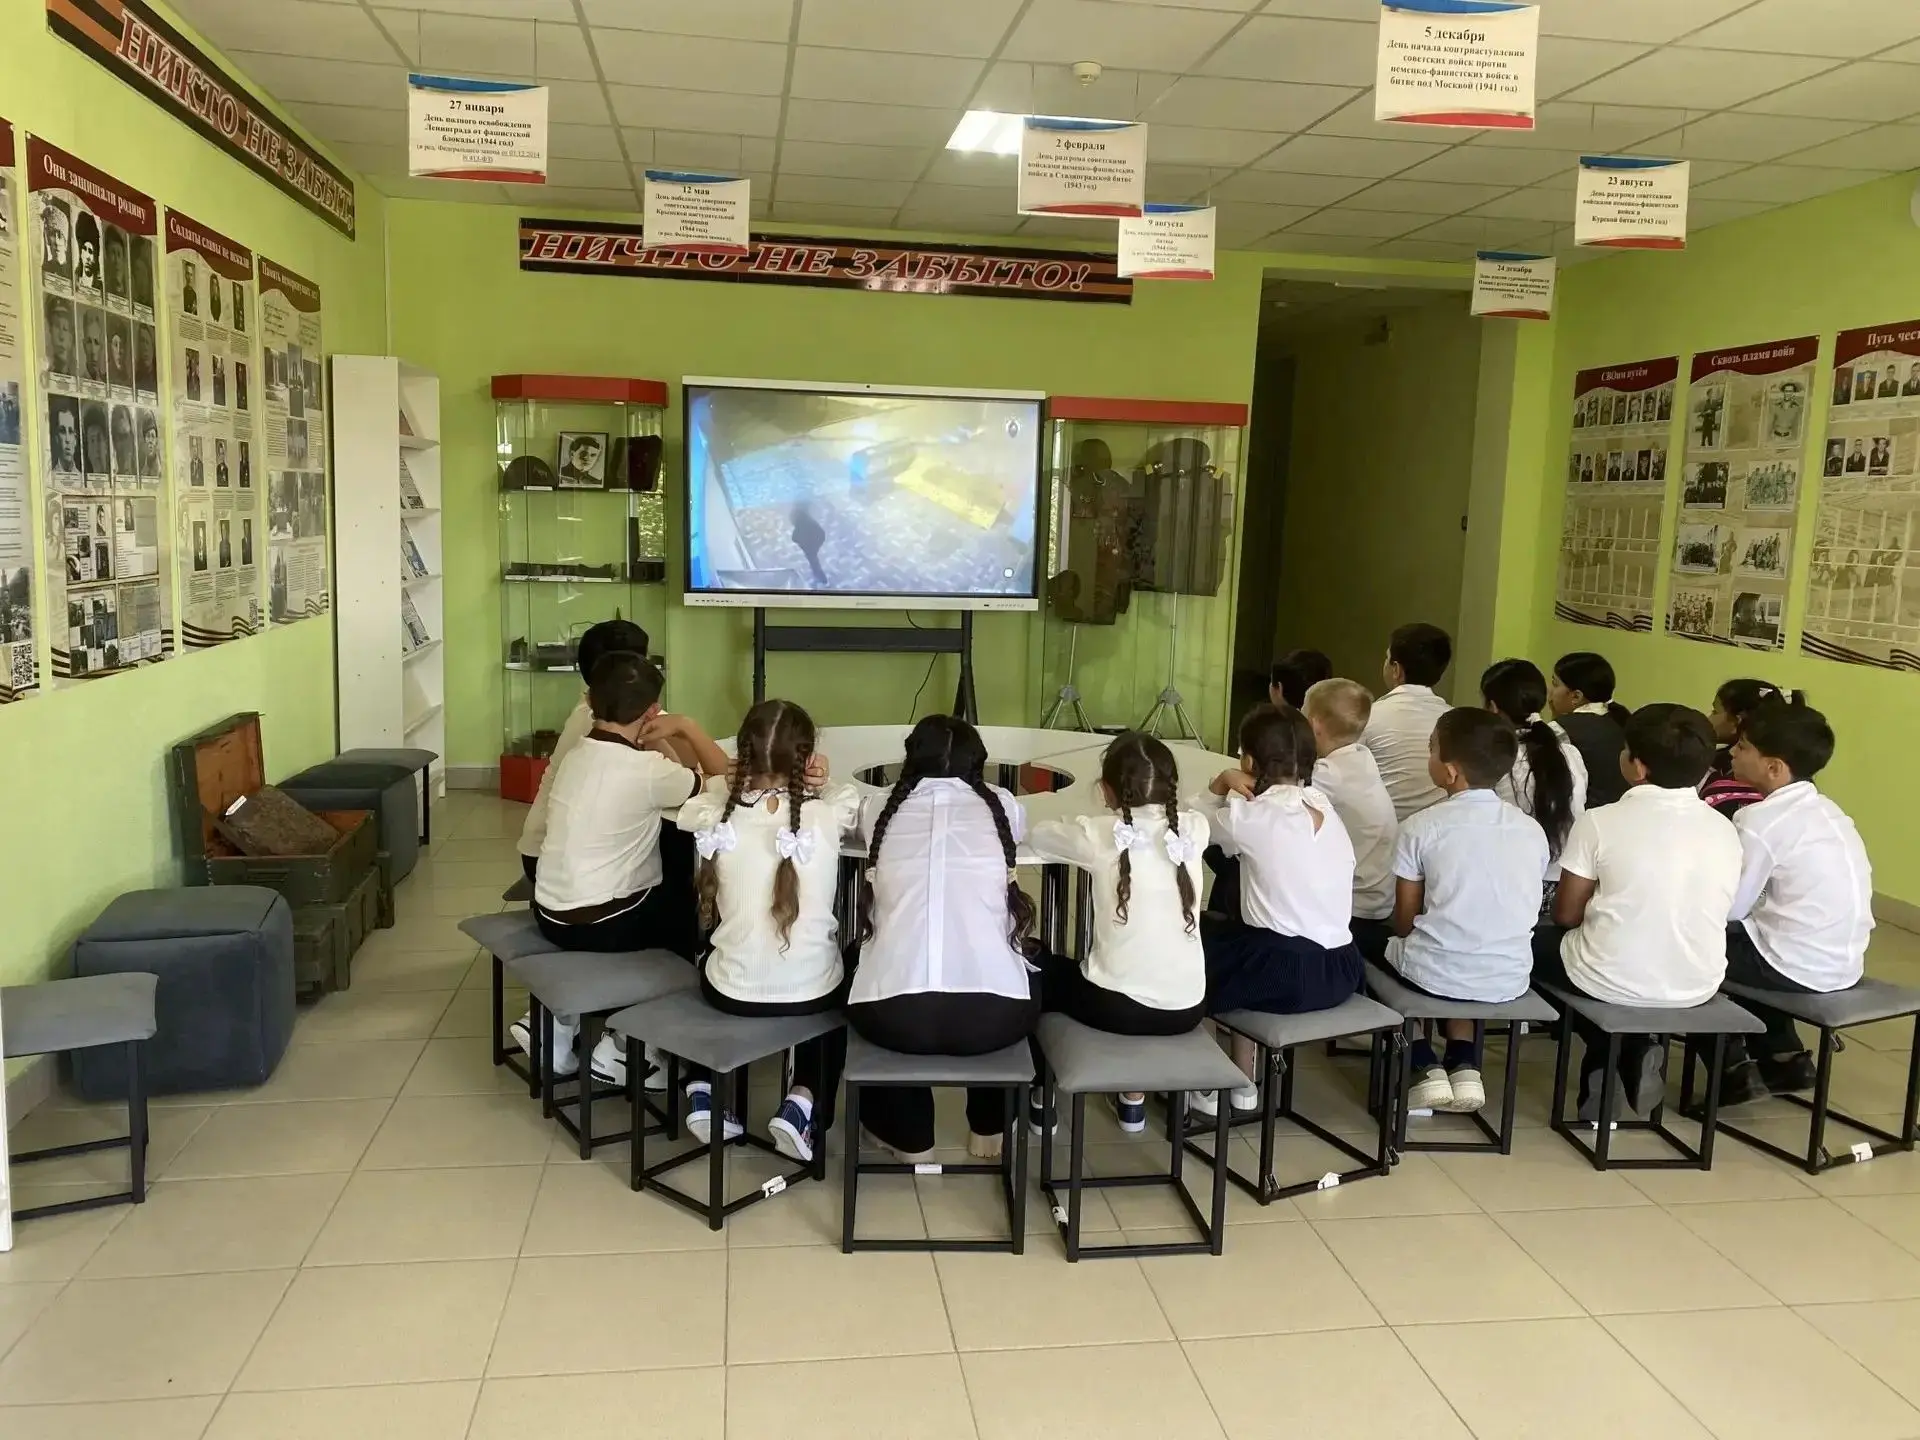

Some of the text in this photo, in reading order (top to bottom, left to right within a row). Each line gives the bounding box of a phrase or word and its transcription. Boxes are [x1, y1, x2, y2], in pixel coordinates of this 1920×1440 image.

[1425, 27, 1485, 44] 5 декабря
[1387, 40, 1525, 58] День начала контрнаступления
[1403, 55, 1507, 69] советских войск против
[1390, 66, 1483, 79] немецко-фашистских
[1486, 71, 1511, 79] войск
[116, 7, 239, 138] НИКТО
[243, 109, 281, 173] НЕ
[1390, 76, 1518, 93] битве под Москвой (1941 год)
[449, 100, 504, 115] 27 января
[424, 114, 531, 129] День полного освобождения
[425, 124, 471, 135] Ленинграда
[483, 129, 530, 138] фашистской
[442, 135, 475, 144] блокады
[477, 137, 496, 145] (1944
[1055, 139, 1105, 151] 2 февраля
[1055, 155, 1085, 163] разгрома
[1055, 172, 1111, 182] Сталинградской
[1608, 177, 1653, 188] 23 августа
[44, 154, 146, 224] Они защищали родину
[1154, 220, 1183, 228] августа
[170, 218, 200, 246] Солдаты
[202, 237, 222, 256] славы
[748, 244, 837, 276] НЕ
[843, 249, 1091, 292] ЗАБЫТО!
[1506, 266, 1532, 274] декабря
[1867, 333, 1895, 348] Путь
[1711, 345, 1795, 365] Сквозь пламя войн
